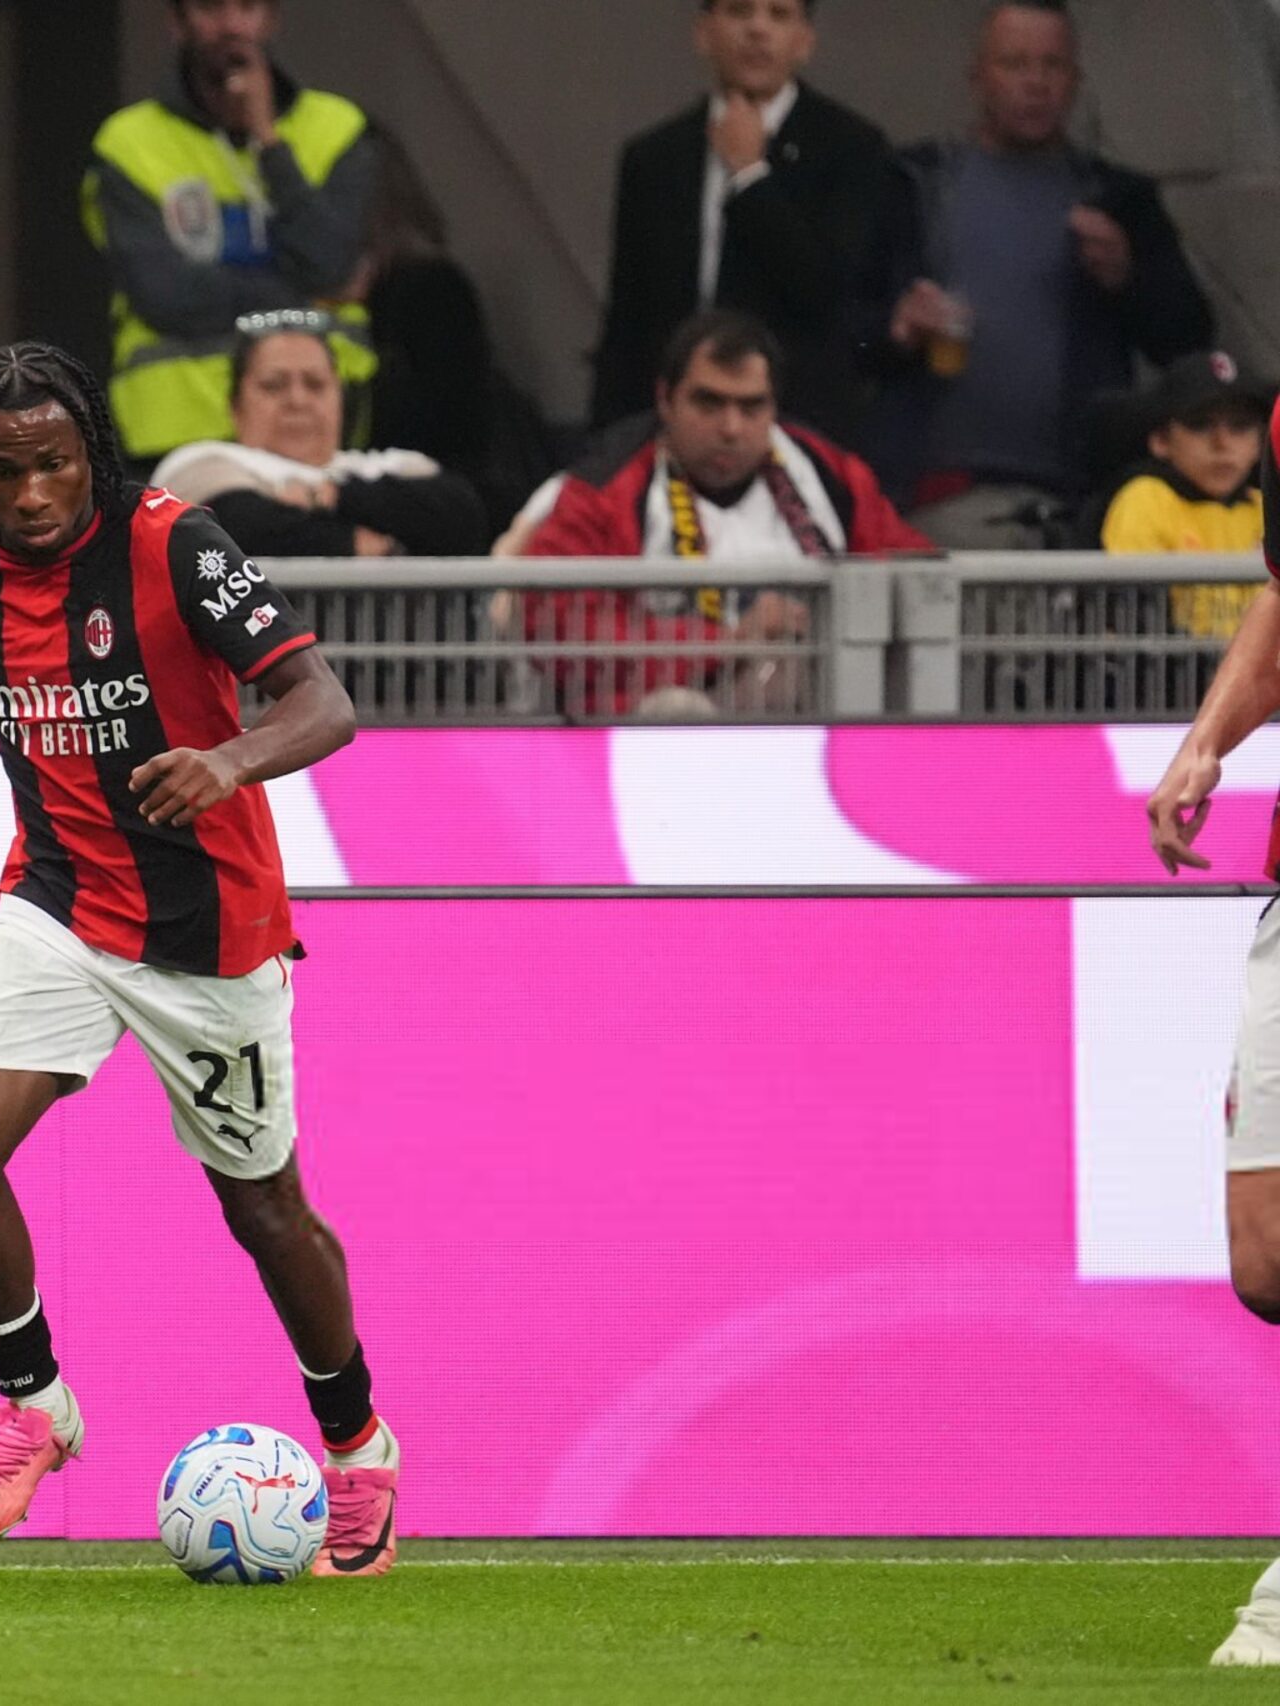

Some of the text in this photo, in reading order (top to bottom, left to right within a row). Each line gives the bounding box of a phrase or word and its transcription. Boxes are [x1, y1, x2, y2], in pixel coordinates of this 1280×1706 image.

[200, 560, 266, 622] MSC
[254, 609, 271, 626] 6
[40, 717, 130, 757] BETTER
[186, 1041, 264, 1113] 21
